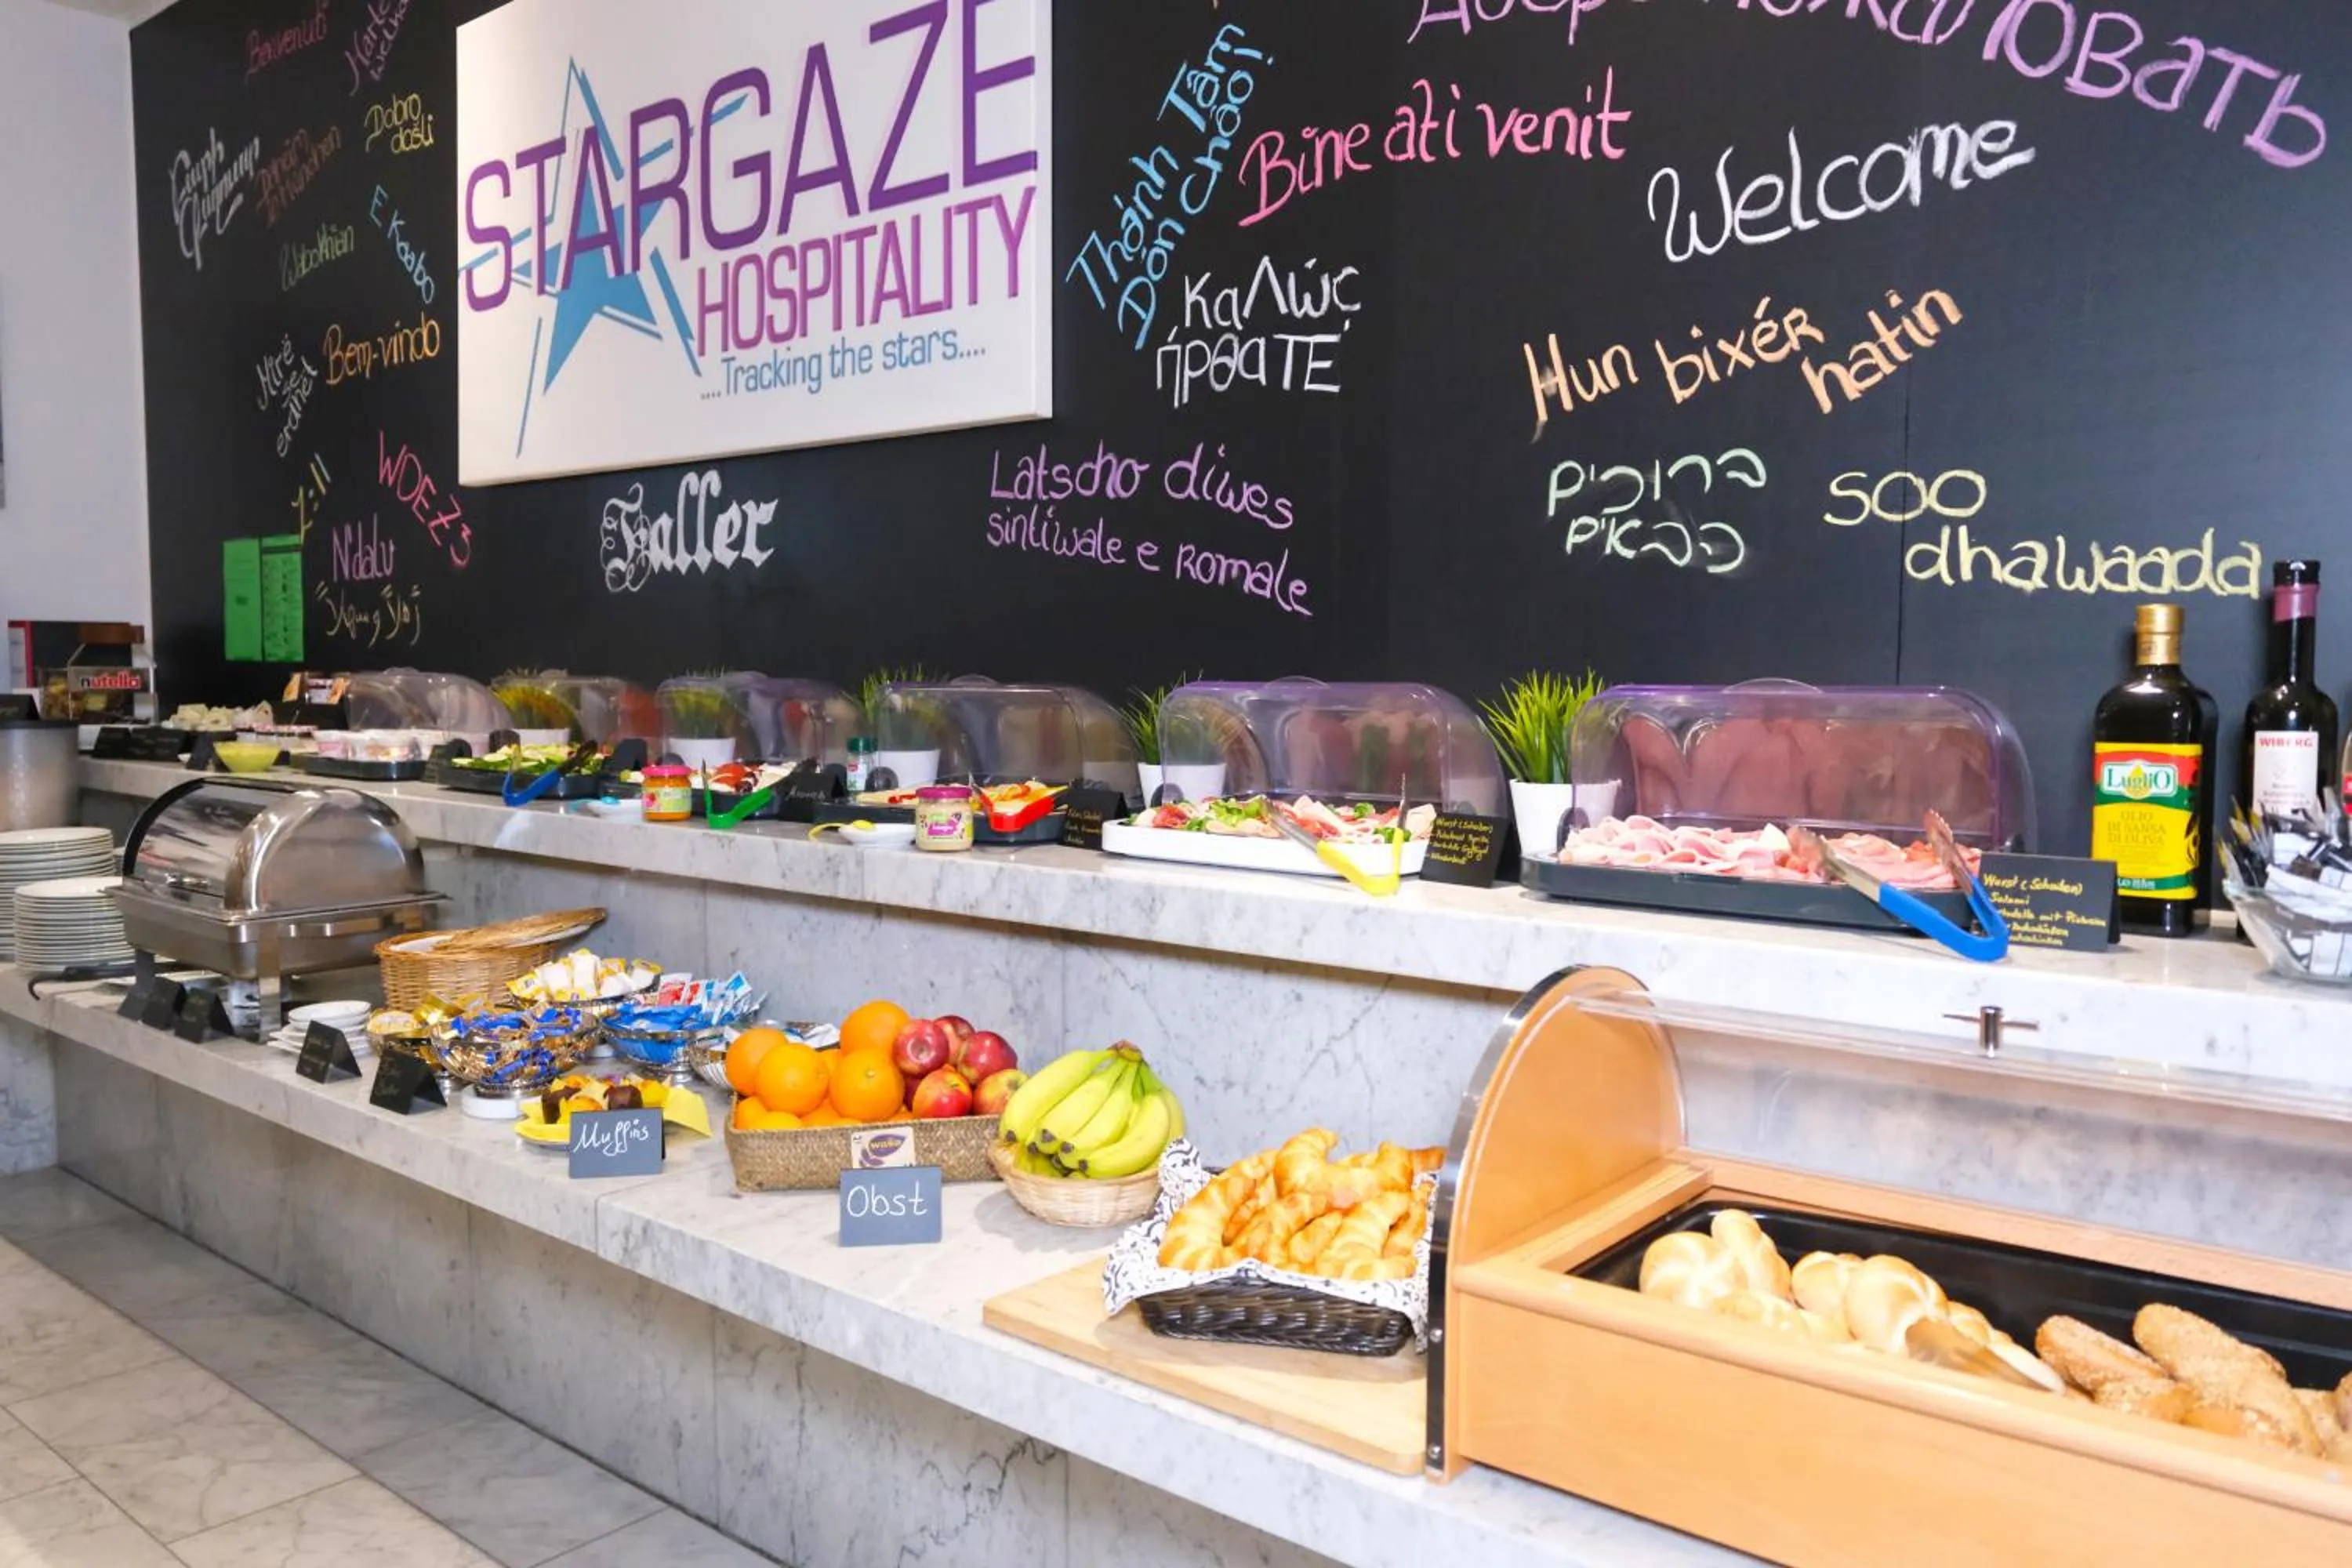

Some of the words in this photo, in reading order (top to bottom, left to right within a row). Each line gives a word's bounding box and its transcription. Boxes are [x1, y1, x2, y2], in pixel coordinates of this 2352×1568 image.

[363, 93, 421, 152] Dobro
[465, 0, 1038, 312] STARGAZE
[1238, 124, 1373, 227] Bine
[1475, 65, 1632, 159] venit
[1647, 119, 2036, 263] Welcome
[698, 186, 1038, 357] HOSPITALITY
[323, 312, 441, 385] Bem-vindo
[829, 336, 873, 379] the
[1524, 332, 1640, 425] Hun
[1802, 289, 1963, 415] hatin
[990, 439, 1150, 500] Latscho
[1164, 441, 1294, 530] diwes
[1548, 448, 1767, 516] ברוכים
[332, 513, 395, 582] Ndalu
[1136, 541, 1160, 572] e
[1904, 524, 2261, 599] dhawaada
[2121, 810, 2153, 822] OLIO
[1983, 873, 2019, 889] Wurst
[1991, 891, 2031, 906] Salami
[573, 1119, 649, 1156] Muffins
[846, 1181, 928, 1218] Obst
